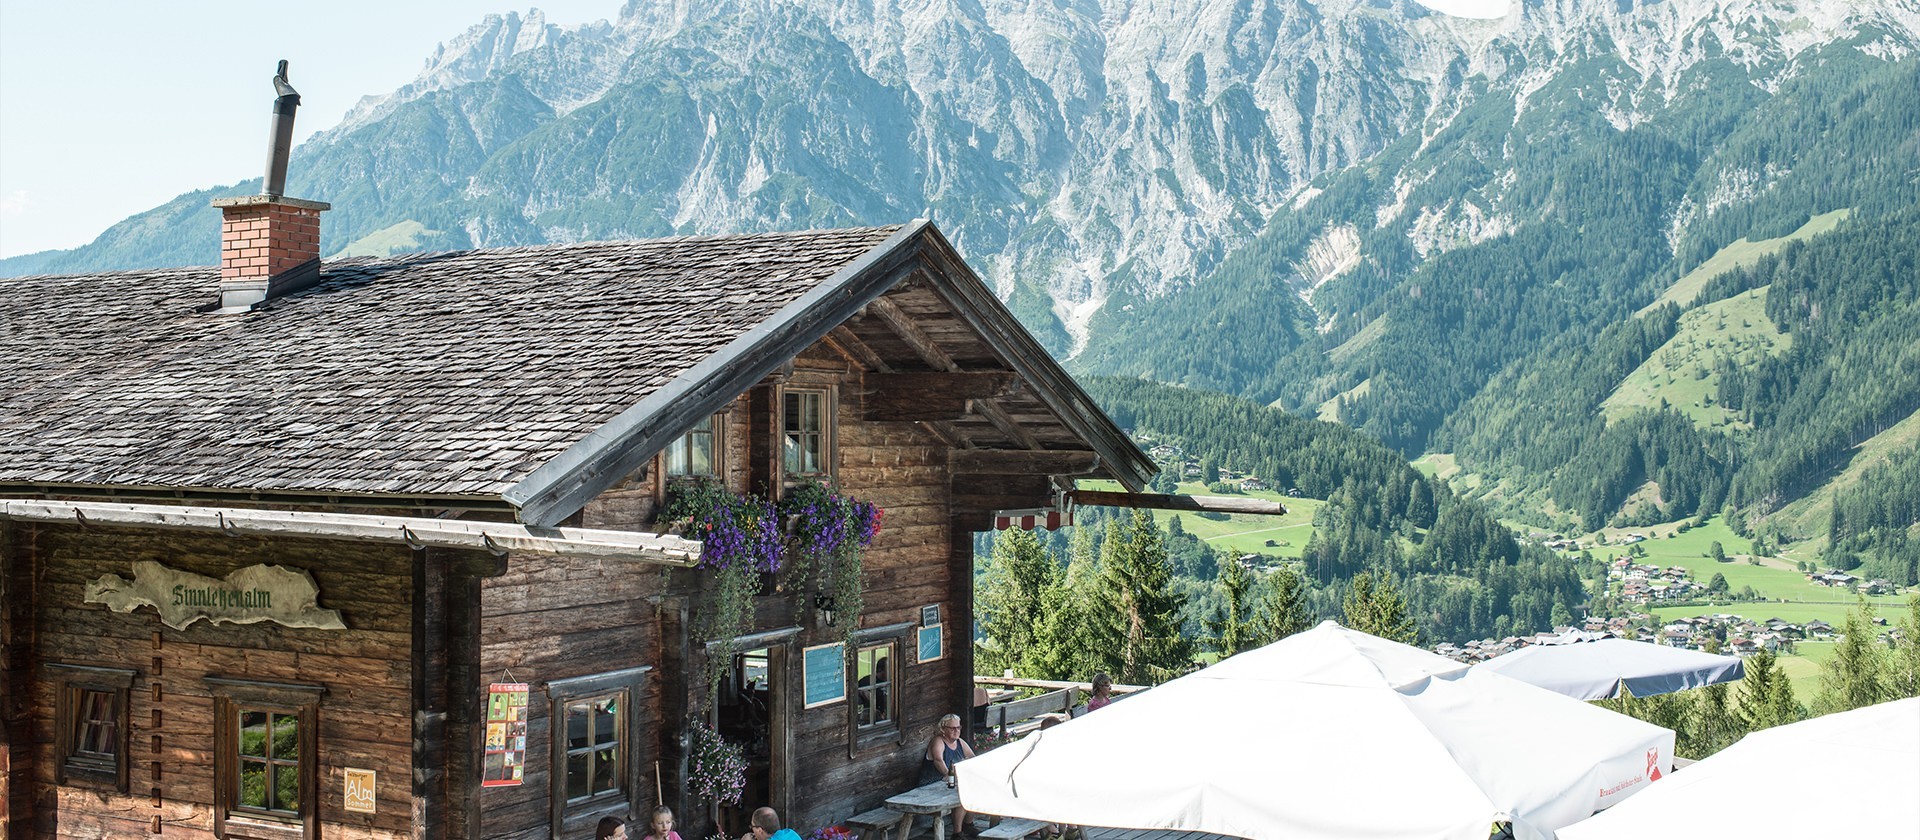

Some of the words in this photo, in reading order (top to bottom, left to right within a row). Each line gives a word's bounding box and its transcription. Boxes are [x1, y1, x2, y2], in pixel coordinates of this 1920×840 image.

[172, 584, 272, 611] Sinnlehenalm
[347, 779, 373, 799] Alm
[347, 799, 373, 809] Sommer
